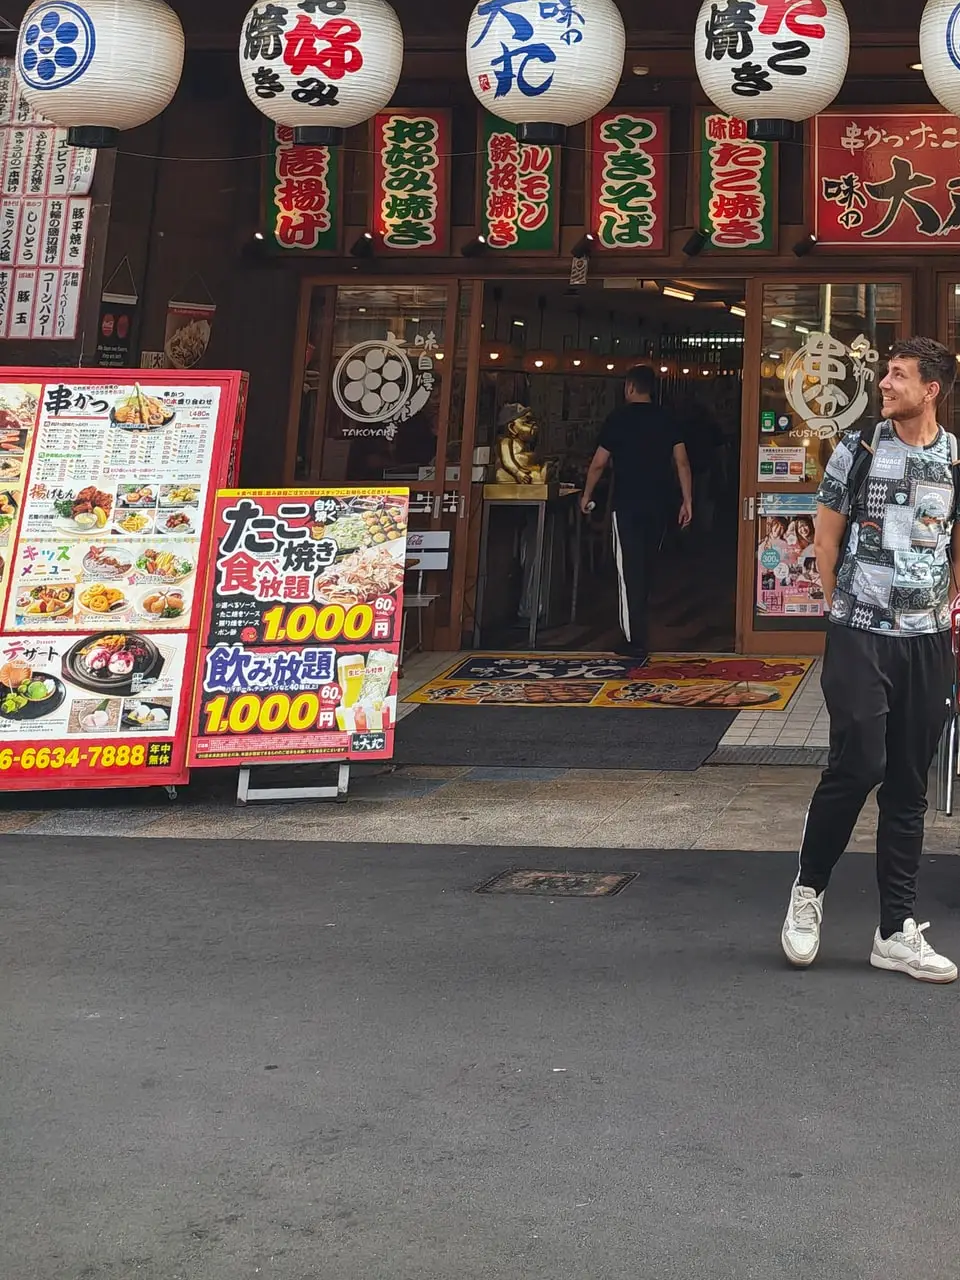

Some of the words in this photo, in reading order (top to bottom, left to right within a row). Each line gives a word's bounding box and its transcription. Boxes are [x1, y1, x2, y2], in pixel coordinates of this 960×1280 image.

[54, 139, 69, 186] エビマヨ
[384, 117, 438, 247] お好み焼き
[602, 116, 655, 248] やきそば
[277, 144, 330, 246] 唐揚げ
[488, 134, 520, 248] 鉄板焼き
[713, 142, 766, 246] たこ焼き
[822, 172, 868, 229] 味の
[22, 210, 39, 261] ししとう
[68, 207, 85, 258] 豚平焼き
[15, 290, 31, 325] 豚玉
[38, 272, 55, 336] コーンバター
[44, 384, 110, 416] 串かつ
[29, 483, 76, 501] 揚げもん
[22, 543, 75, 562] キッズ
[222, 500, 336, 572] たこ焼き
[20, 563, 71, 578] メニュー
[220, 551, 312, 600] 食べ放題
[2, 639, 60, 663] デザート
[207, 647, 334, 689] 飲み放題
[148, 754, 171, 765] 無休
[149, 743, 172, 754] 年中
